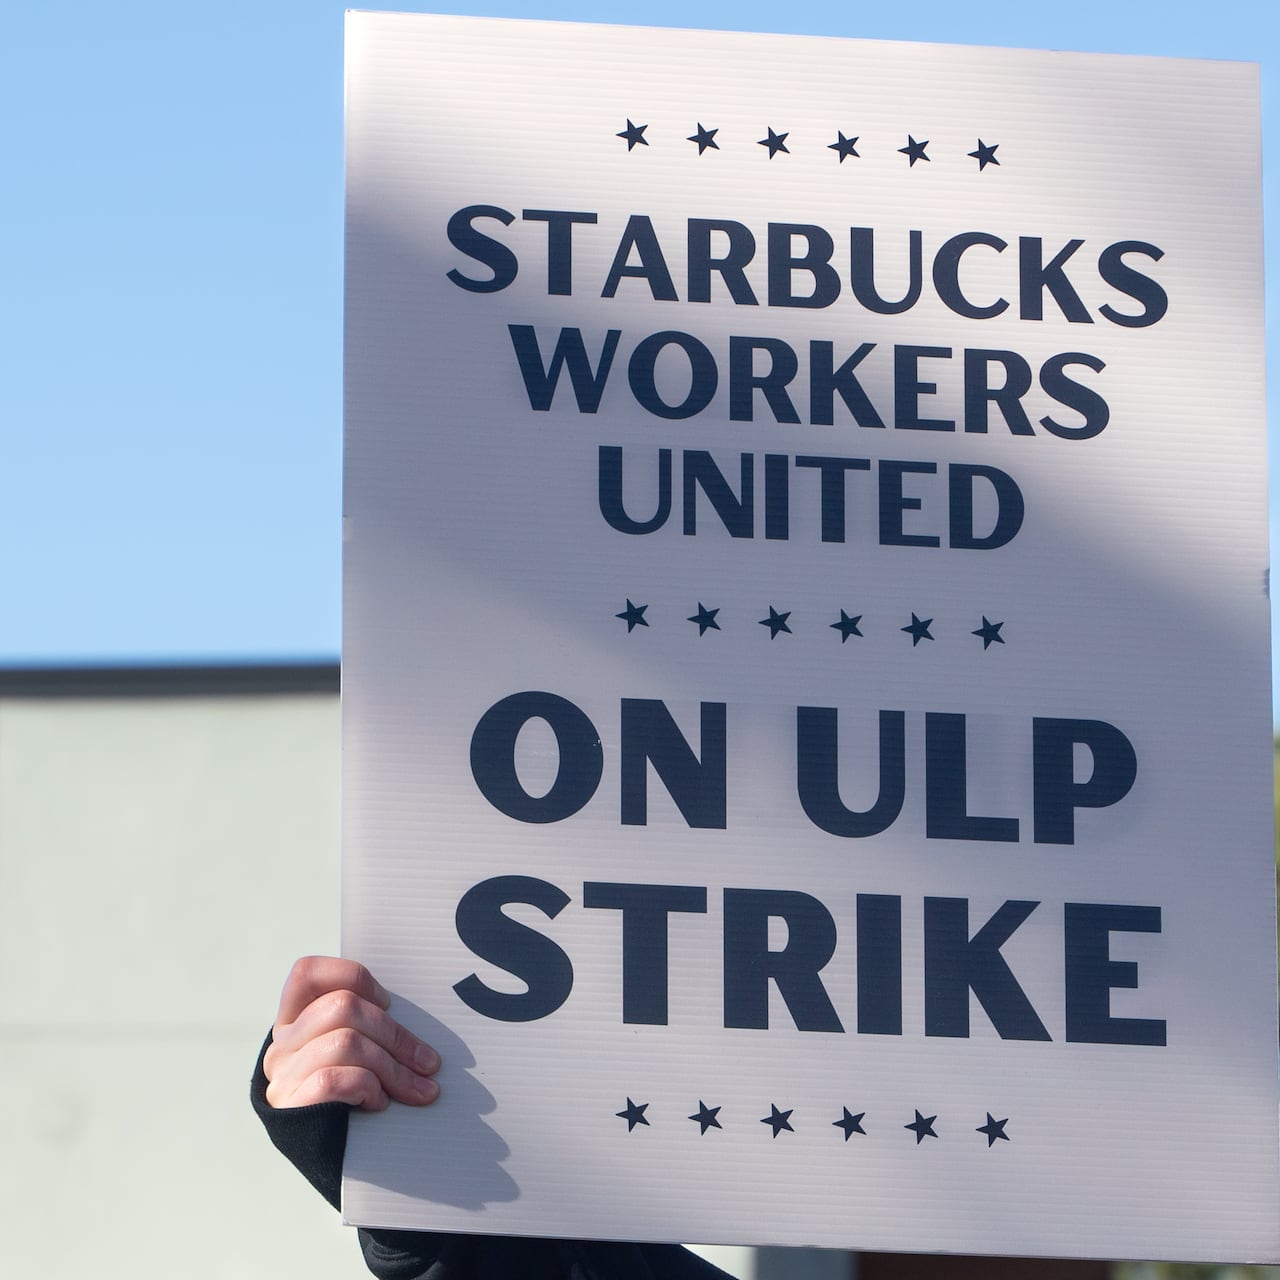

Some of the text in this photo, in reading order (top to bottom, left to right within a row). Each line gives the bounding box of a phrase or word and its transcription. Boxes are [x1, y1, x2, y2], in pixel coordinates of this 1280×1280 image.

[446, 205, 1168, 328] STARBUCKS
[508, 324, 1110, 441] WORKERS
[598, 446, 1025, 551] UNITED
[470, 691, 1138, 845] ON ULP
[452, 876, 1167, 1047] STRIKE
